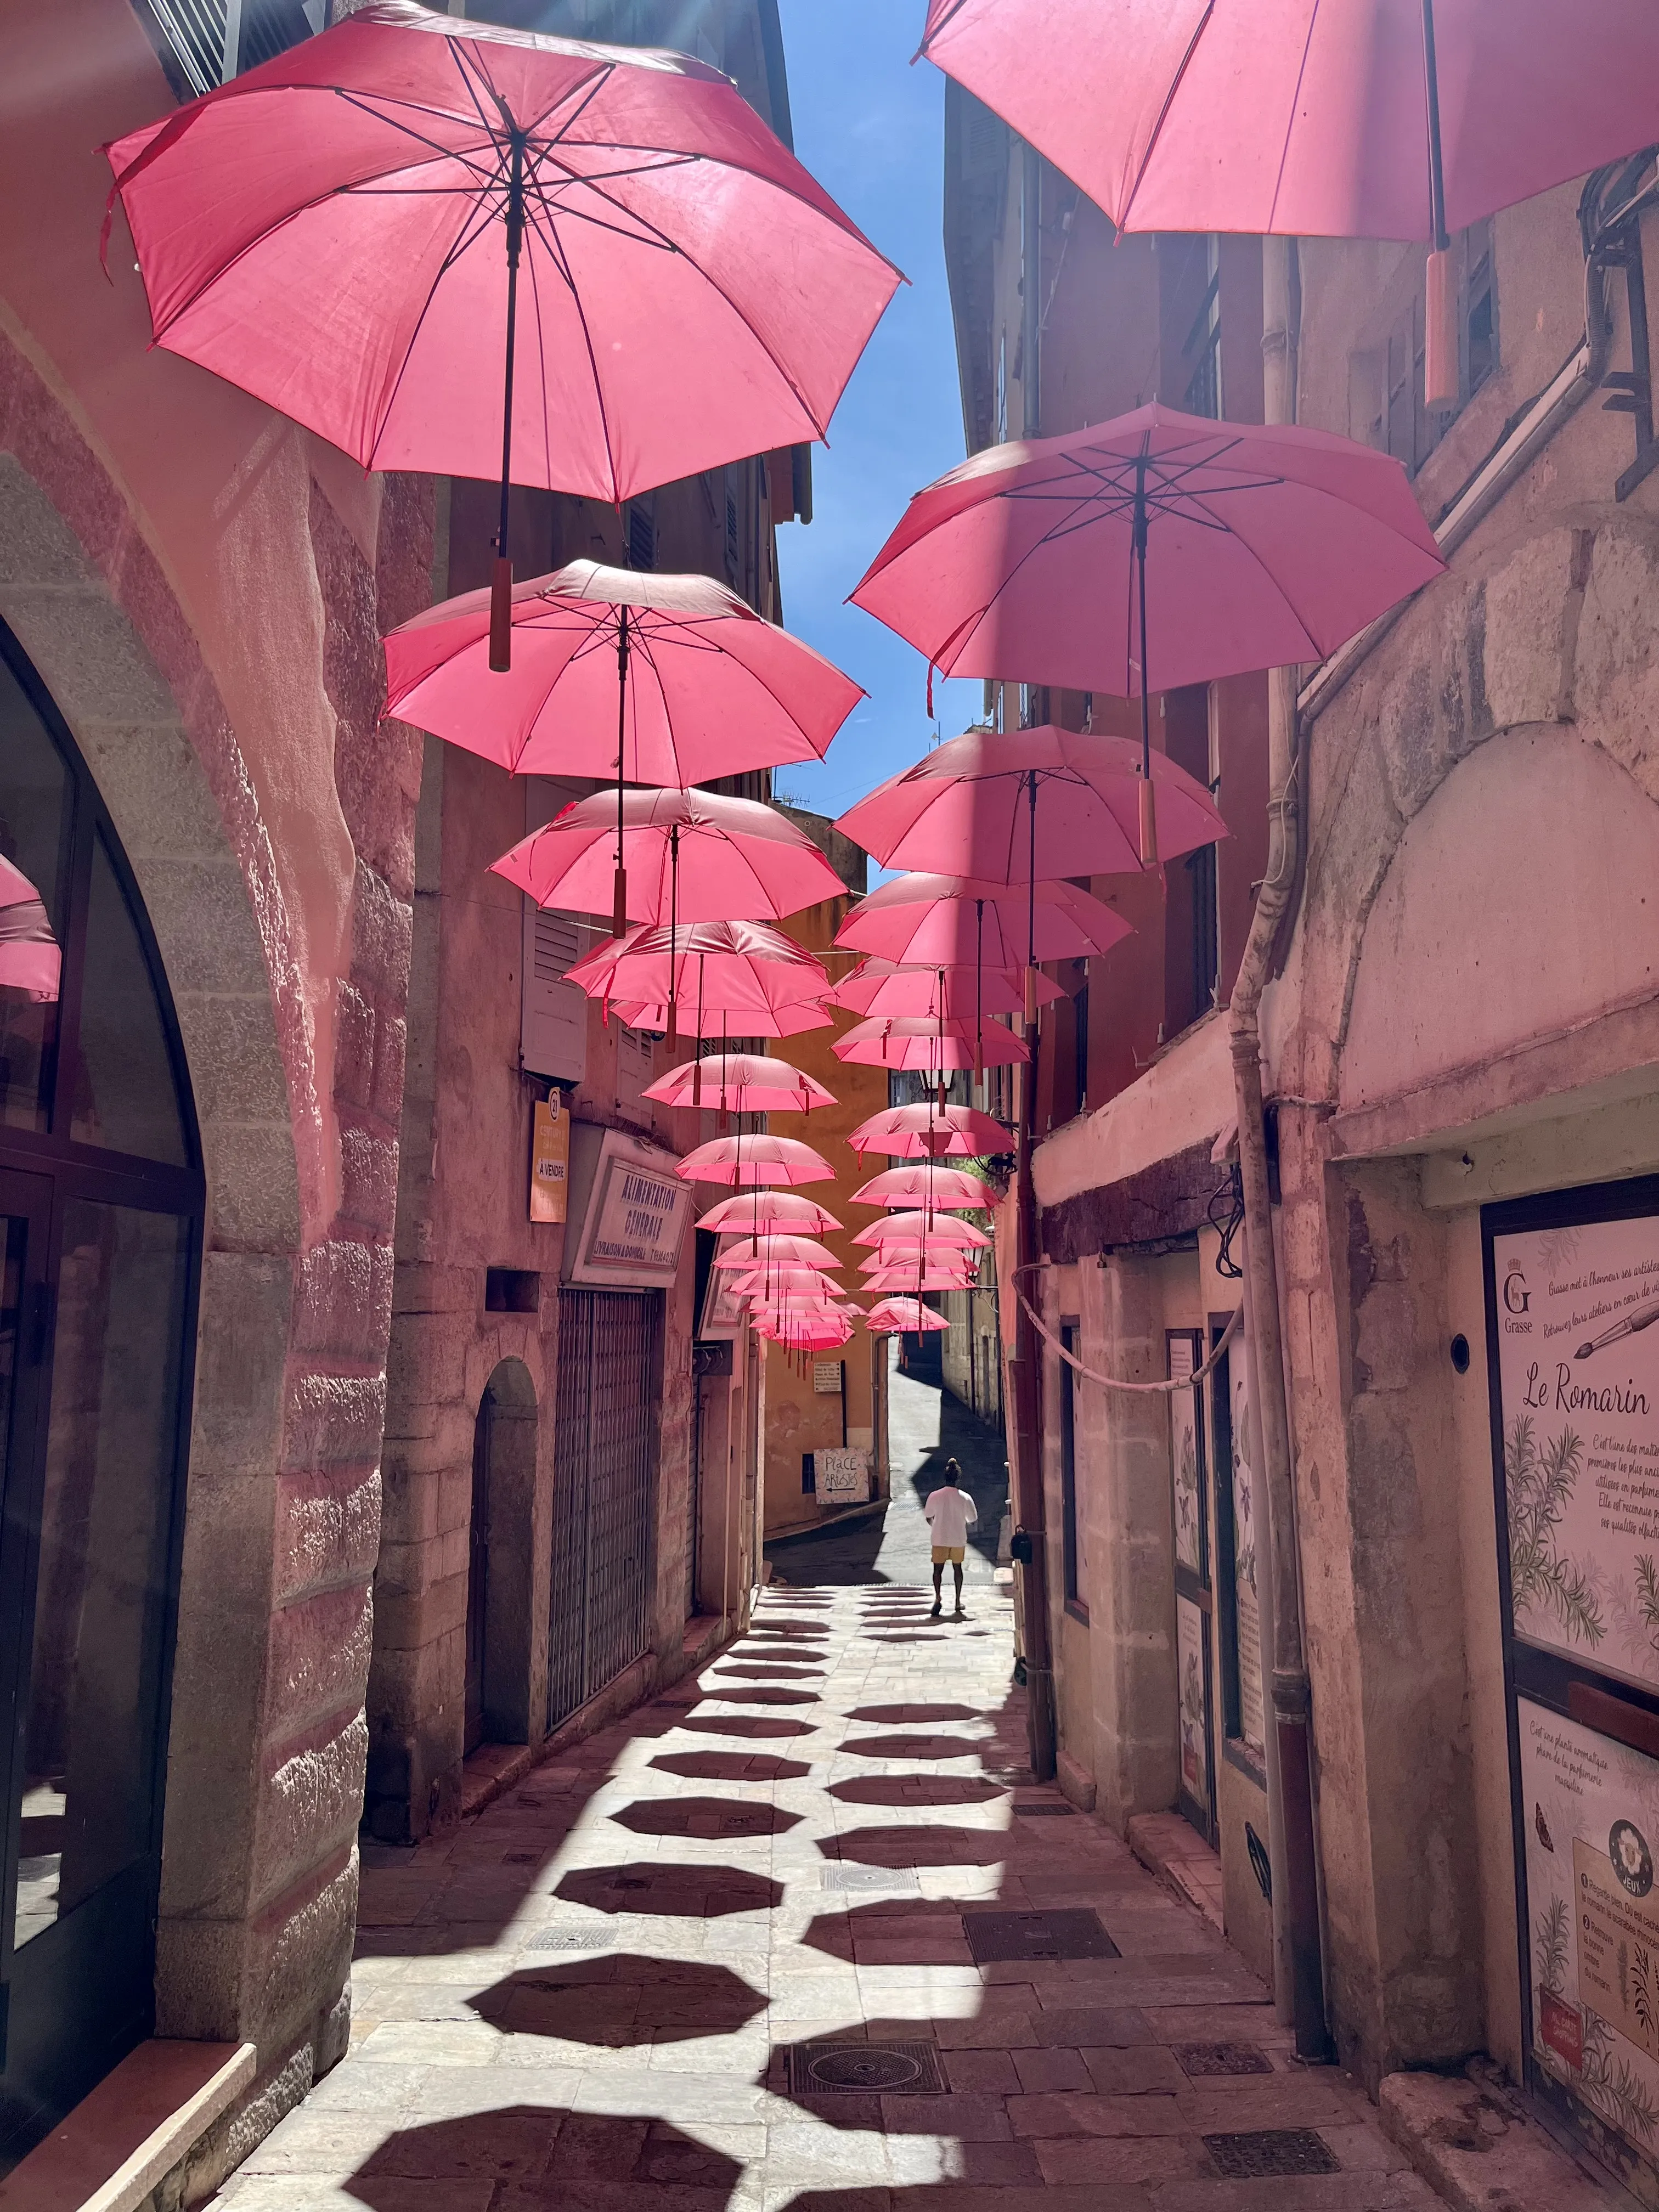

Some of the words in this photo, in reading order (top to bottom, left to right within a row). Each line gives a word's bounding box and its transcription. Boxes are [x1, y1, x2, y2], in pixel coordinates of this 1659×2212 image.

[545, 1164, 564, 1178] VENDRE
[622, 1175, 676, 1211] ALIMENTATION
[594, 1240, 622, 1257] LIVRAISON
[1549, 1282, 1568, 1296] Grasse
[1570, 1279, 1582, 1290] met
[1583, 1276, 1587, 1286] à
[1589, 1271, 1620, 1286] l'honneur
[1621, 1269, 1632, 1279] ses
[1543, 1319, 1571, 1339] Retrouvez
[1572, 1312, 1587, 1326] leurs
[1588, 1301, 1612, 1319] ateliers
[1613, 1301, 1622, 1310] en
[1623, 1291, 1640, 1306] cœur
[1641, 1281, 1650, 1297] de
[1505, 1317, 1532, 1333] Grasse
[1523, 1362, 1549, 1408] Le
[1556, 1363, 1650, 1414] Romarin
[1593, 1434, 1609, 1450] C'est
[1610, 1436, 1624, 1452] l'une
[1627, 1438, 1637, 1455] des
[1587, 1458, 1616, 1471] premières
[1618, 1457, 1627, 1472] les
[1628, 1459, 1643, 1479] plus
[1621, 1483, 1629, 1492] en
[1599, 1492, 1611, 1509] Elle
[1613, 1498, 1622, 1511] est
[1623, 1502, 1652, 1516] reconnue
[1601, 1518, 1609, 1529] ses
[1611, 1517, 1637, 1535] qualités
[1530, 1720, 1545, 1738] C'est
[1544, 1732, 1554, 1743] une
[1554, 1734, 1573, 1752] plante
[1574, 1747, 1608, 1772] aromatique
[1536, 1743, 1552, 1760] phare
[1554, 1751, 1561, 1764] de
[1562, 1754, 1568, 1769] la
[1569, 1763, 1602, 1786] parfumerie
[1623, 1874, 1641, 1893] JEUX
[1634, 1911, 1643, 1923] est
